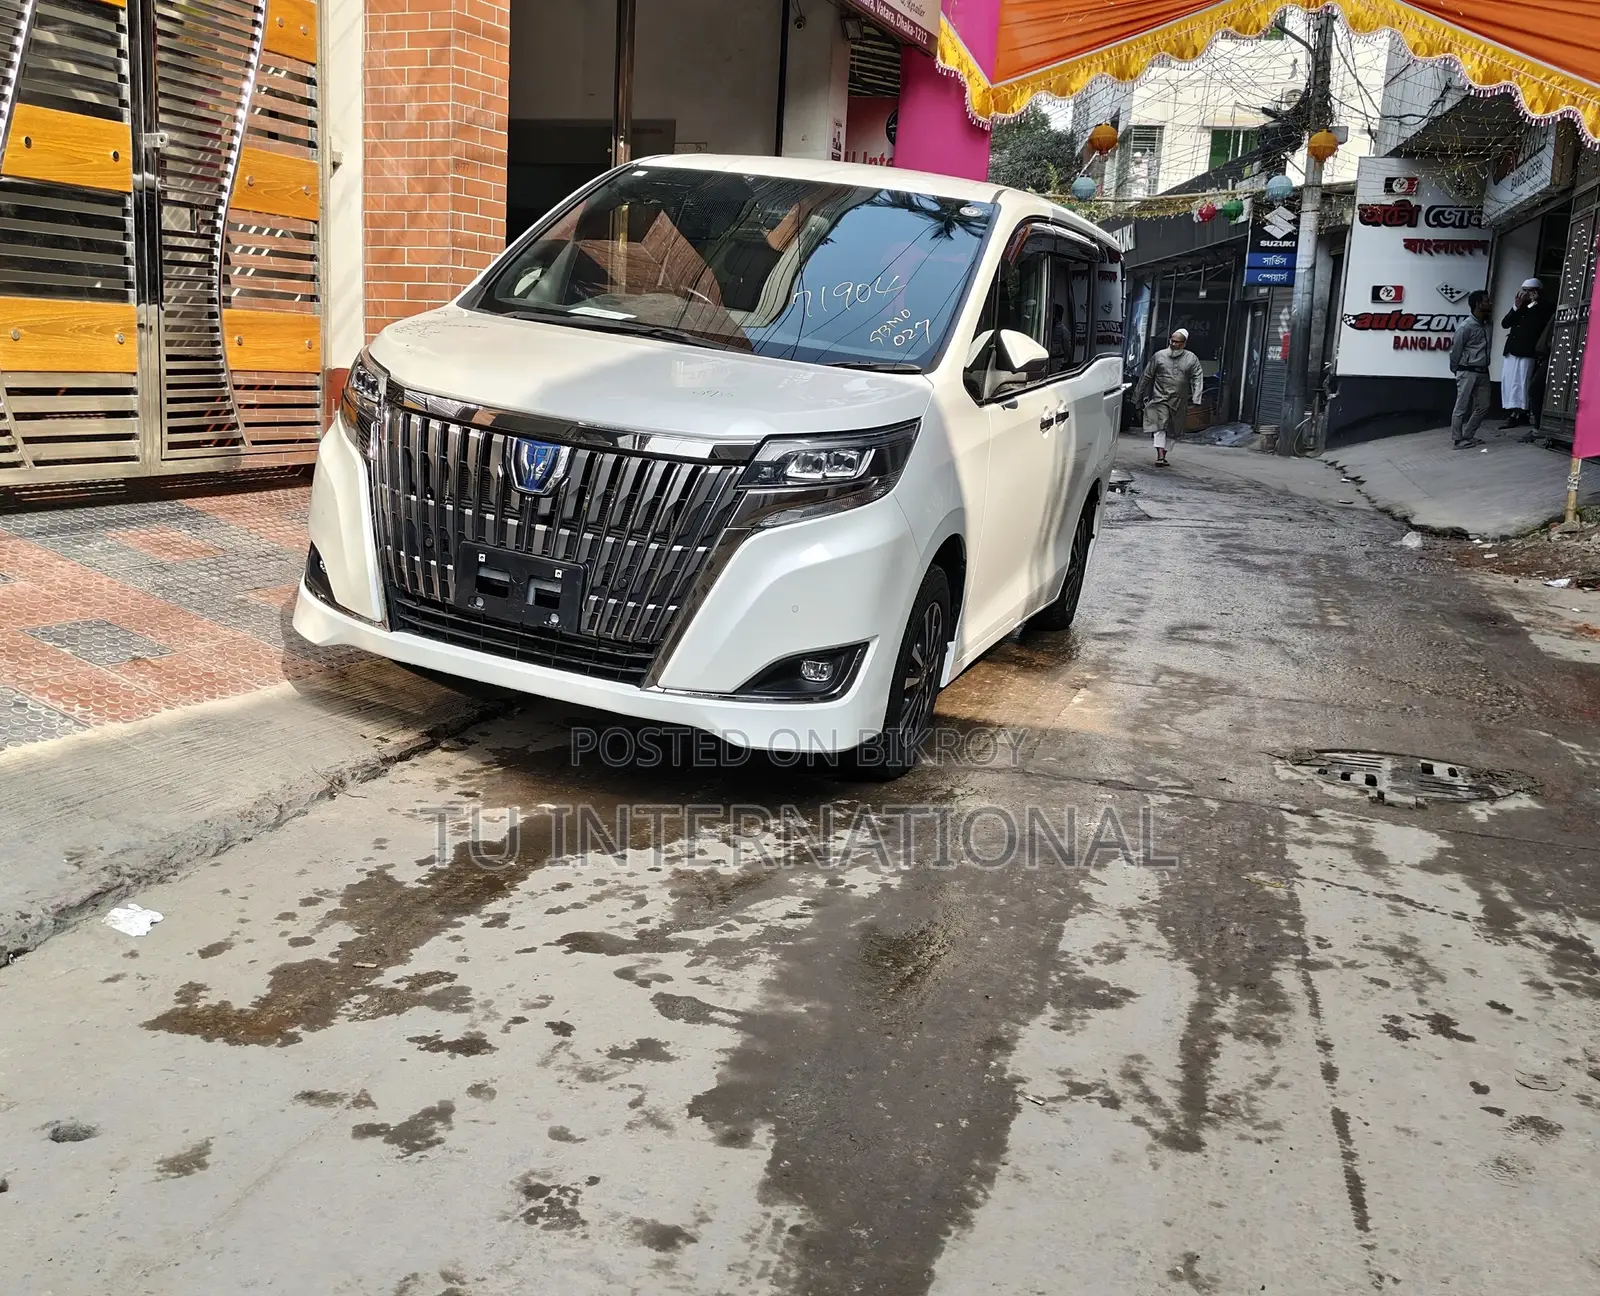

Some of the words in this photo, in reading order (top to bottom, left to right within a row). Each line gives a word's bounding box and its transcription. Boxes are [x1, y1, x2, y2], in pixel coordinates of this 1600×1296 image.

[896, 14, 928, 45] Dhaka-1212
[1260, 240, 1295, 248] SUZUKI
[793, 275, 907, 318] 71904
[893, 319, 931, 346] 027
[1355, 310, 1470, 332] autoZON
[1393, 336, 1455, 351] BANGLAD
